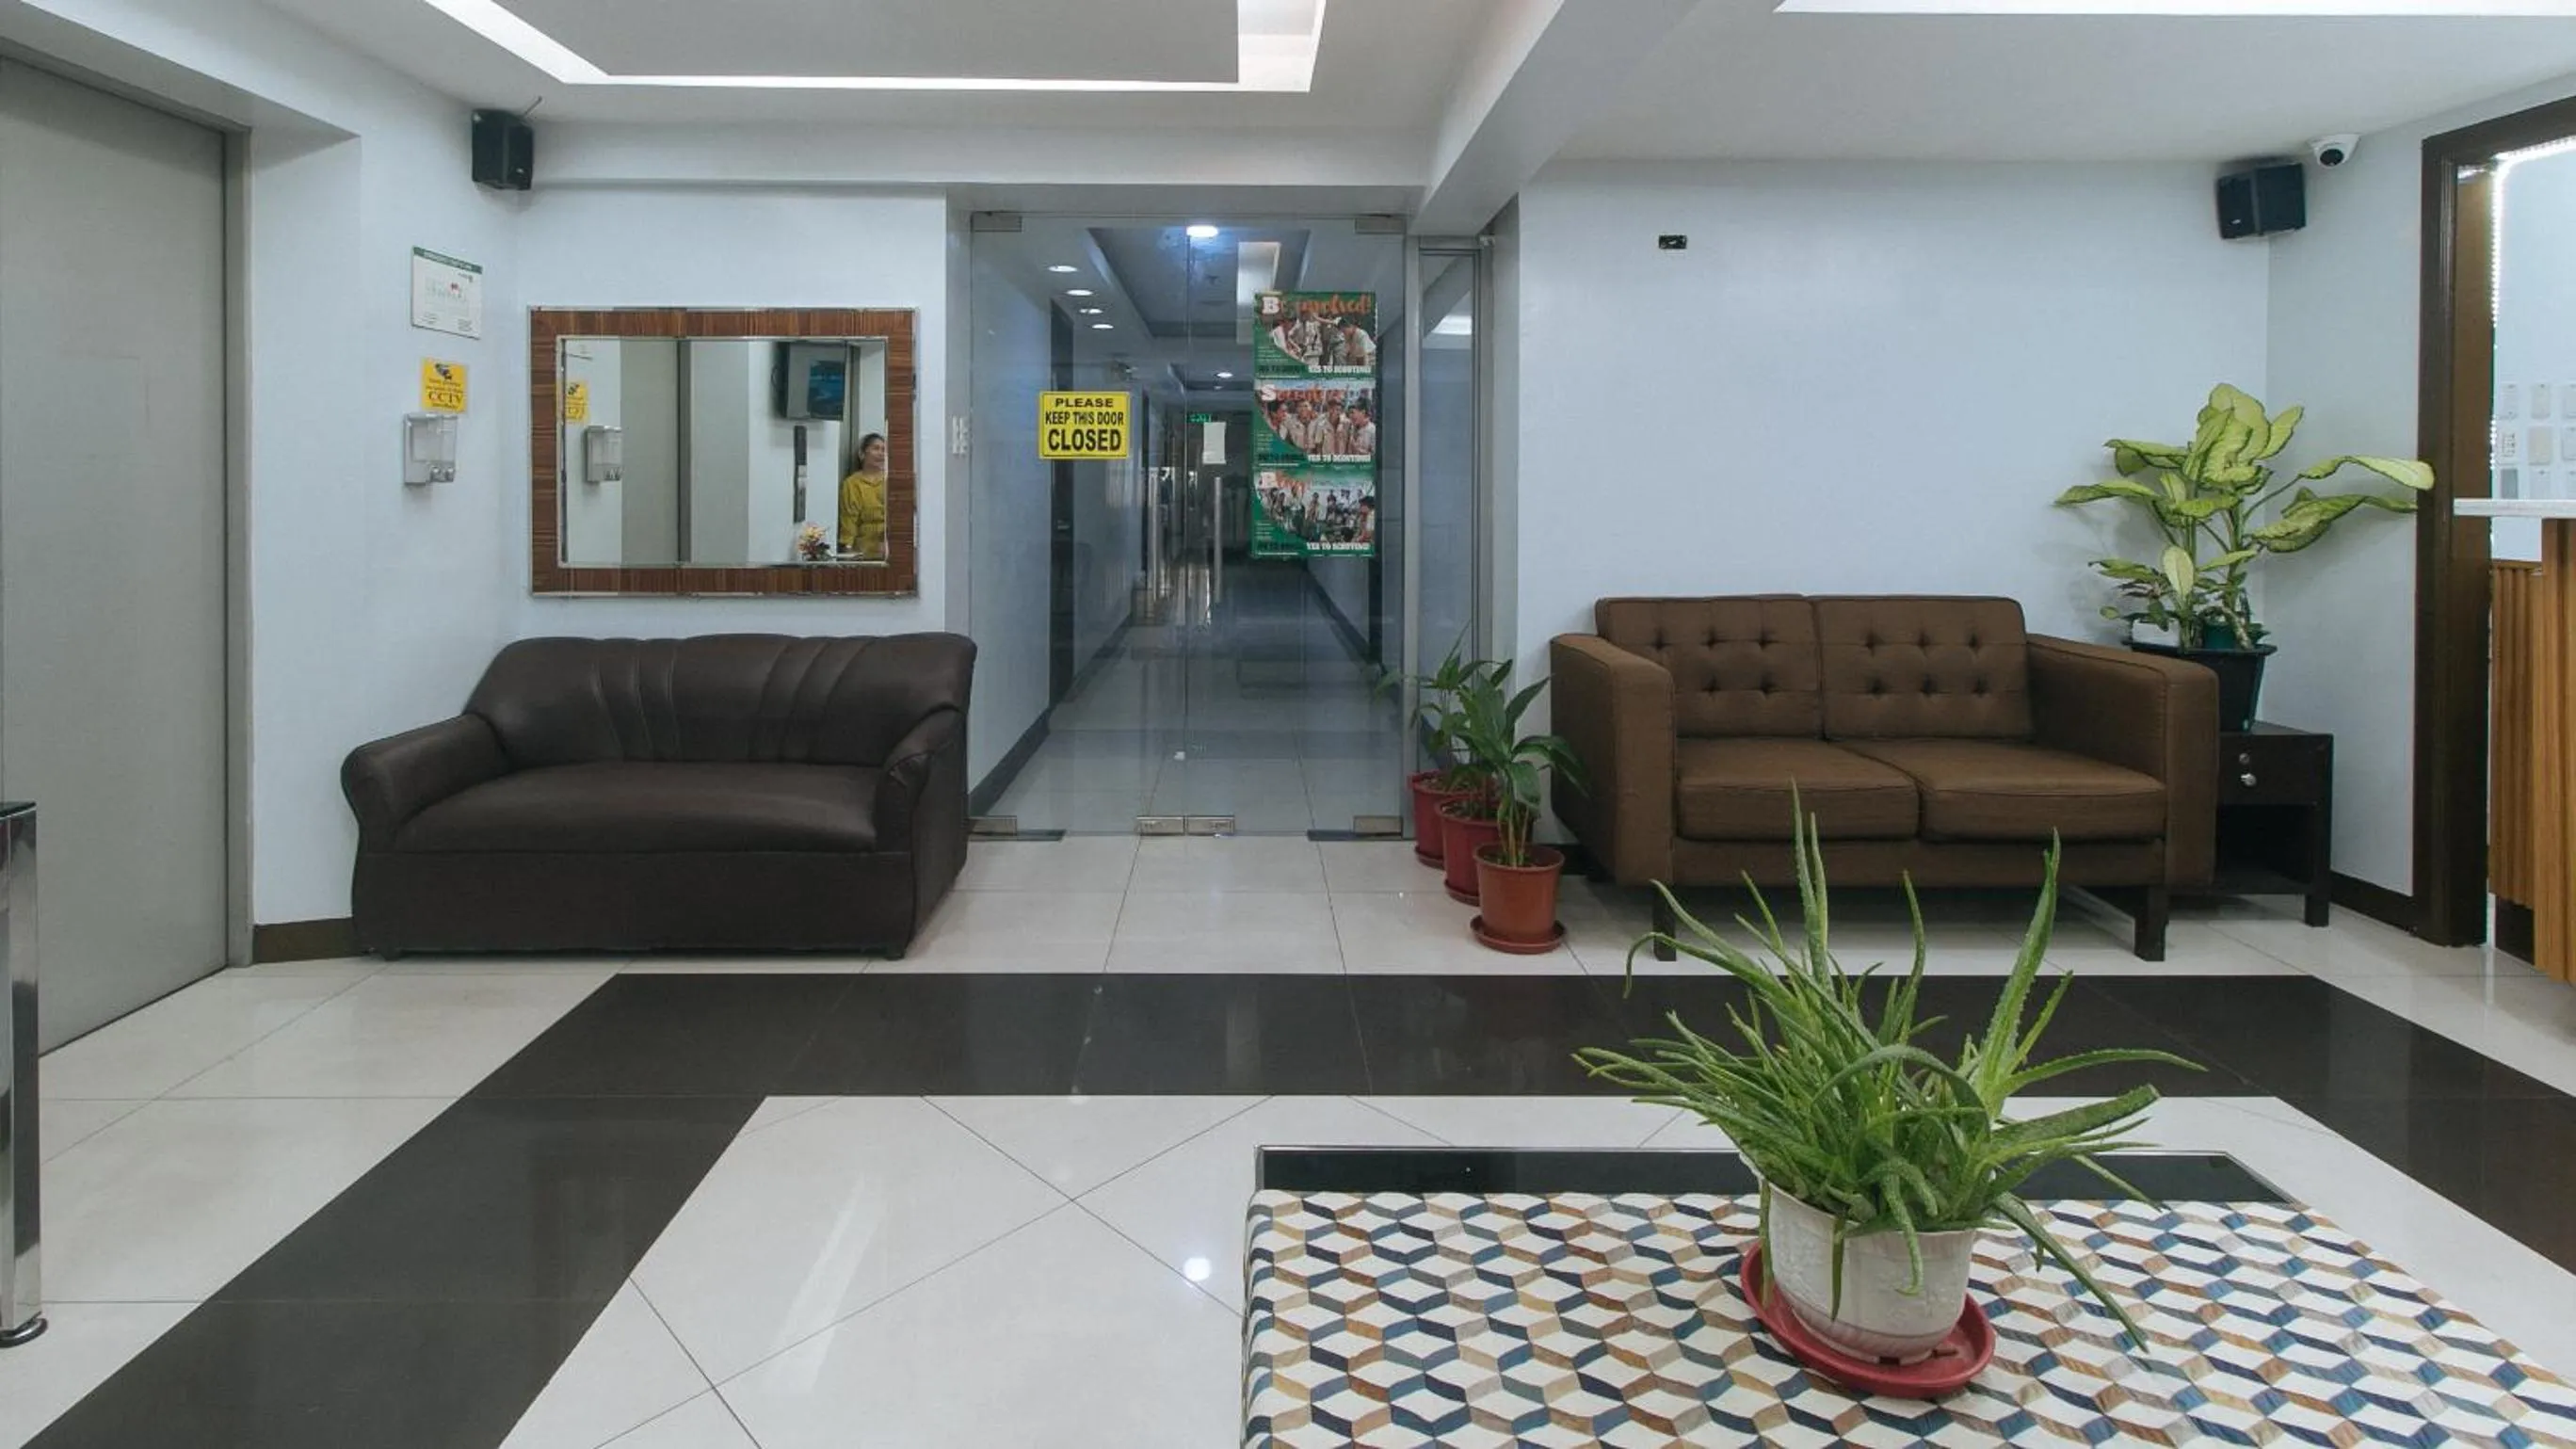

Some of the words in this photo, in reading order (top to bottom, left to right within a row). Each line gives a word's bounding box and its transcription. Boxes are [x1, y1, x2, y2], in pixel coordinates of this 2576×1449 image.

[428, 392, 463, 404] CCTV
[1055, 397, 1114, 408] PLEASE
[1045, 411, 1071, 425] KEEP
[1073, 411, 1095, 425] THIS
[1097, 411, 1124, 426] DOOR
[1048, 428, 1122, 451] CLOSED
